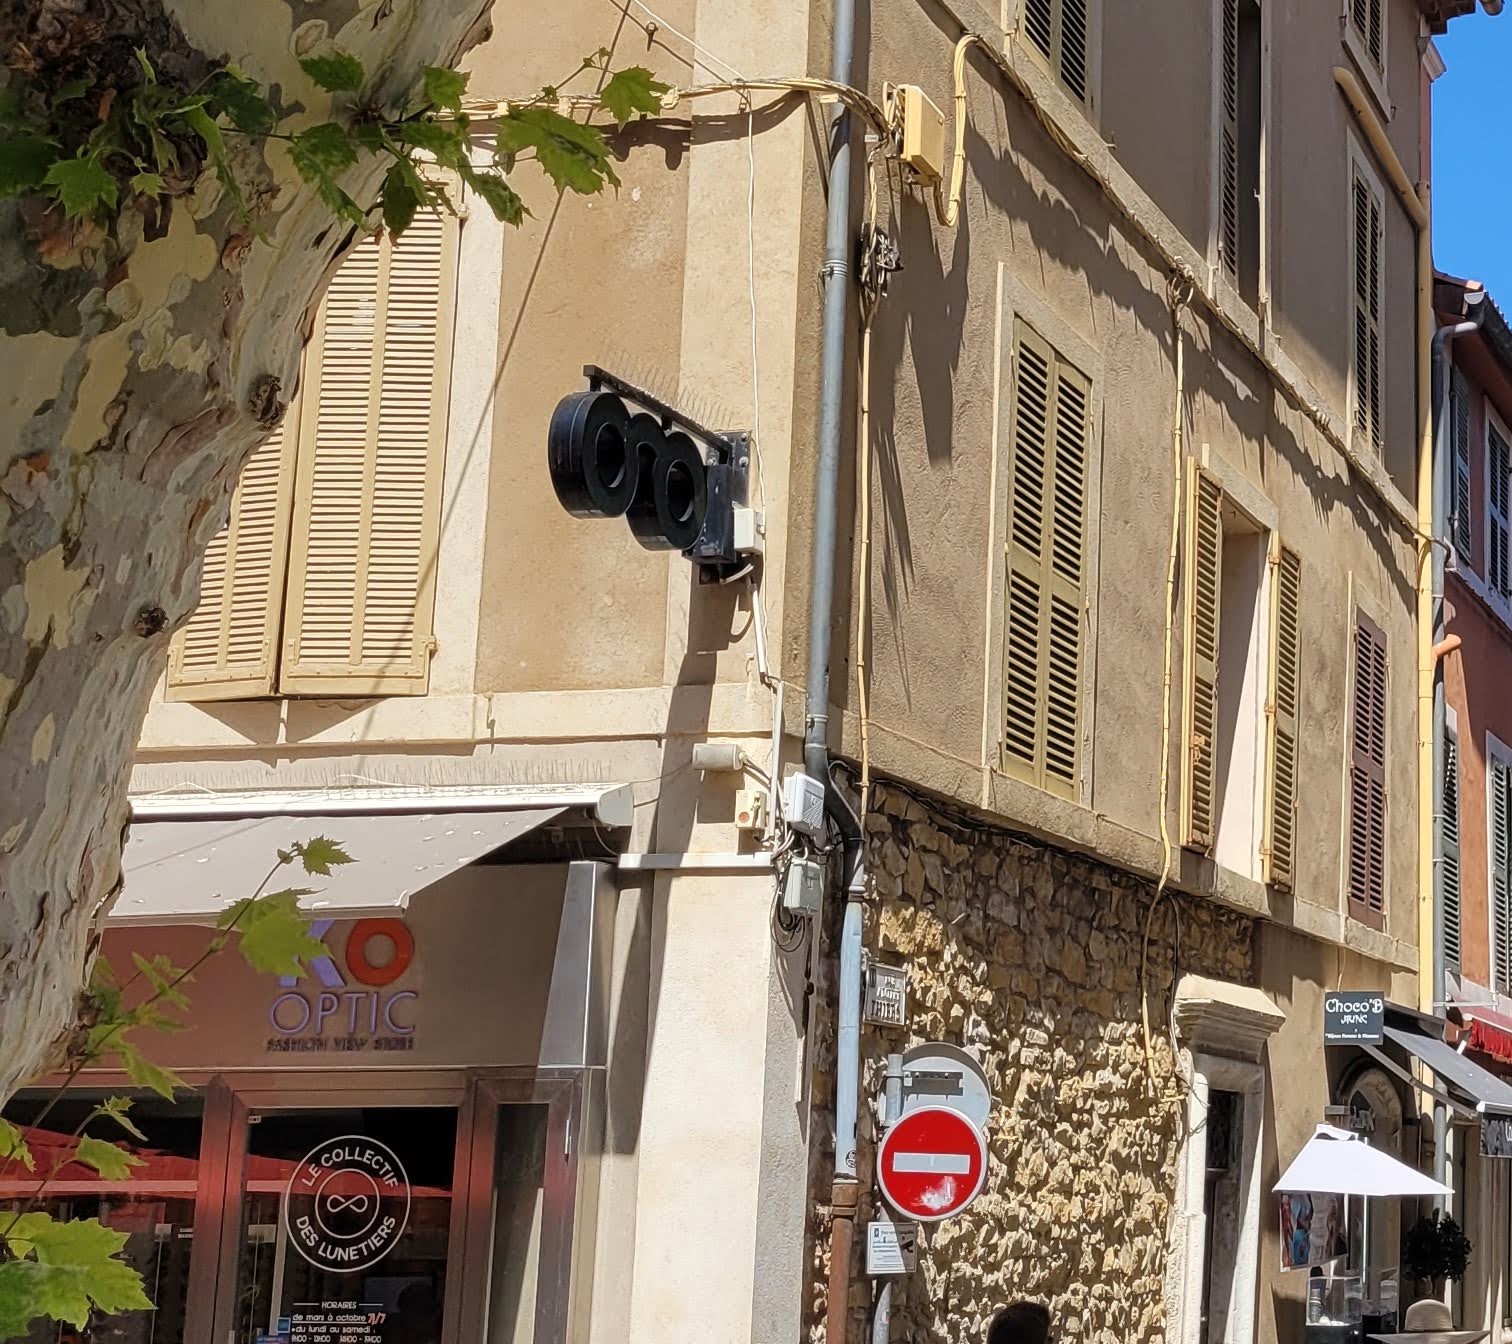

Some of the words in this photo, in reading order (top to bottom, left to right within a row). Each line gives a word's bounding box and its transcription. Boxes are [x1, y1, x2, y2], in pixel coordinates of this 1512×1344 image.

[270, 991, 418, 1035] OPTIC
[1325, 998, 1384, 1013] Choco'B
[302, 1164, 322, 1186] LE
[321, 1146, 399, 1188] COLLECTIF
[296, 1216, 319, 1246] DES
[318, 1216, 396, 1261] LUNETIERS
[321, 1301, 357, 1309] HORAIRES
[327, 1313, 333, 1321] à
